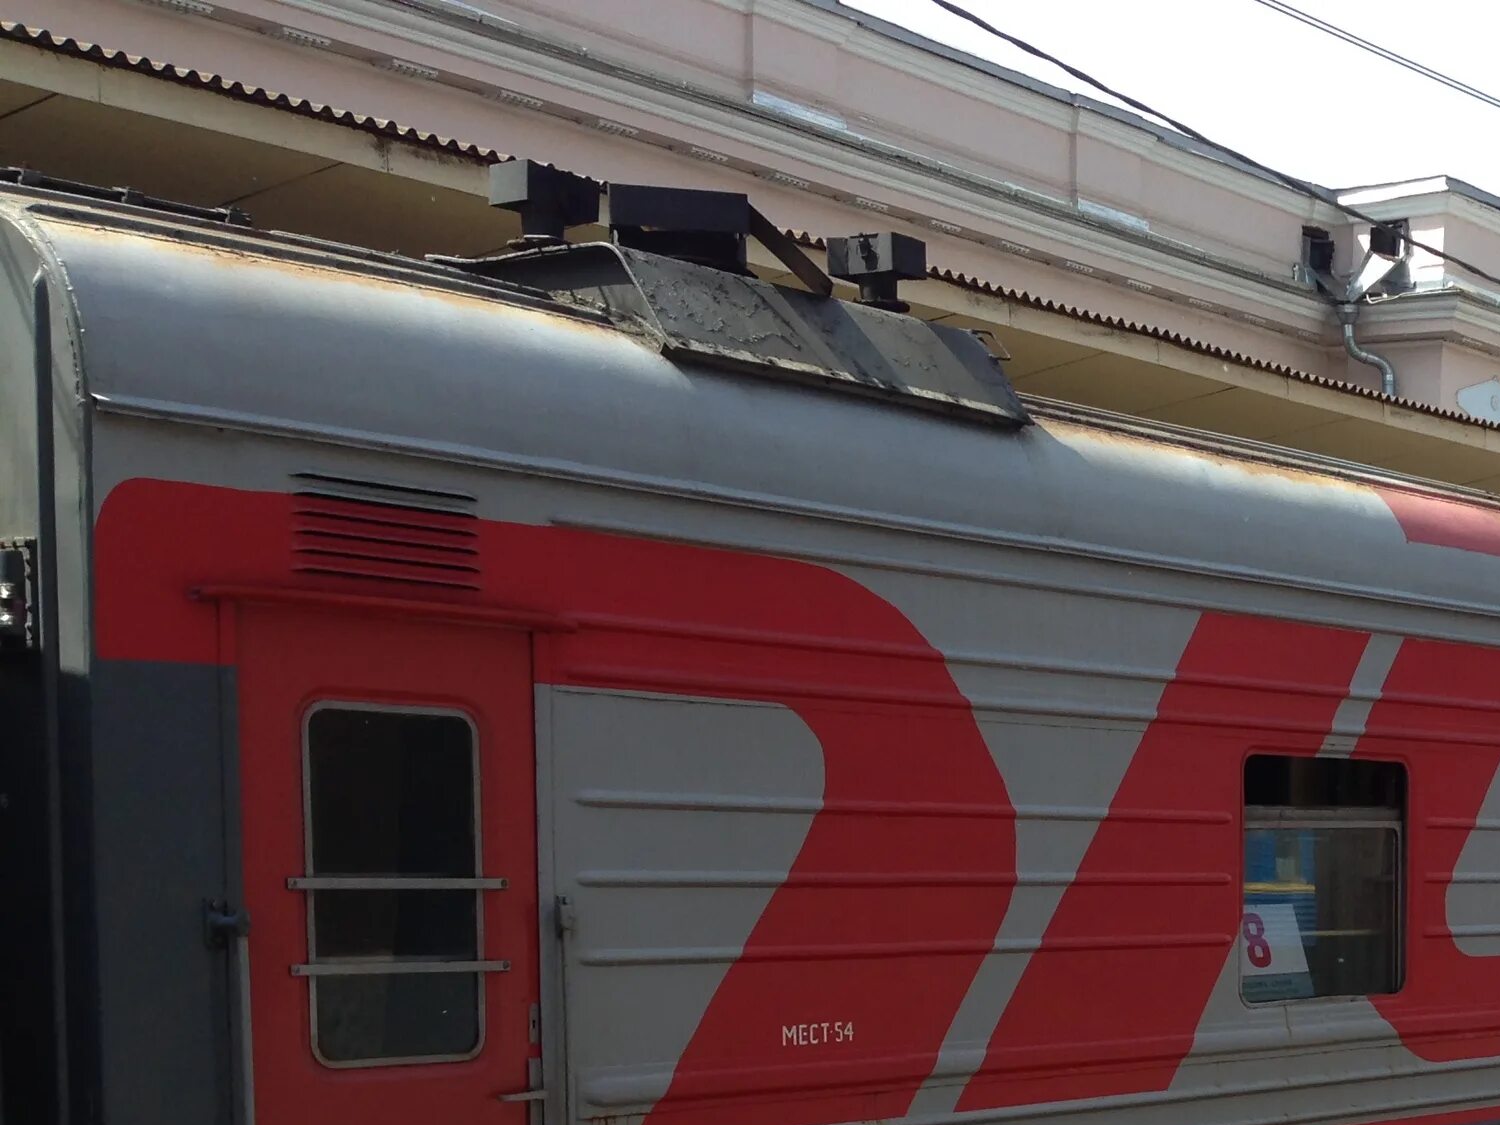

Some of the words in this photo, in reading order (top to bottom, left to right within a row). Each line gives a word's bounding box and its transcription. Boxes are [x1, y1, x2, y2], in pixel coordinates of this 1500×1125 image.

[1242, 913, 1272, 968] 8
[781, 1022, 831, 1047] МЕСТ
[834, 1021, 855, 1042] 54
